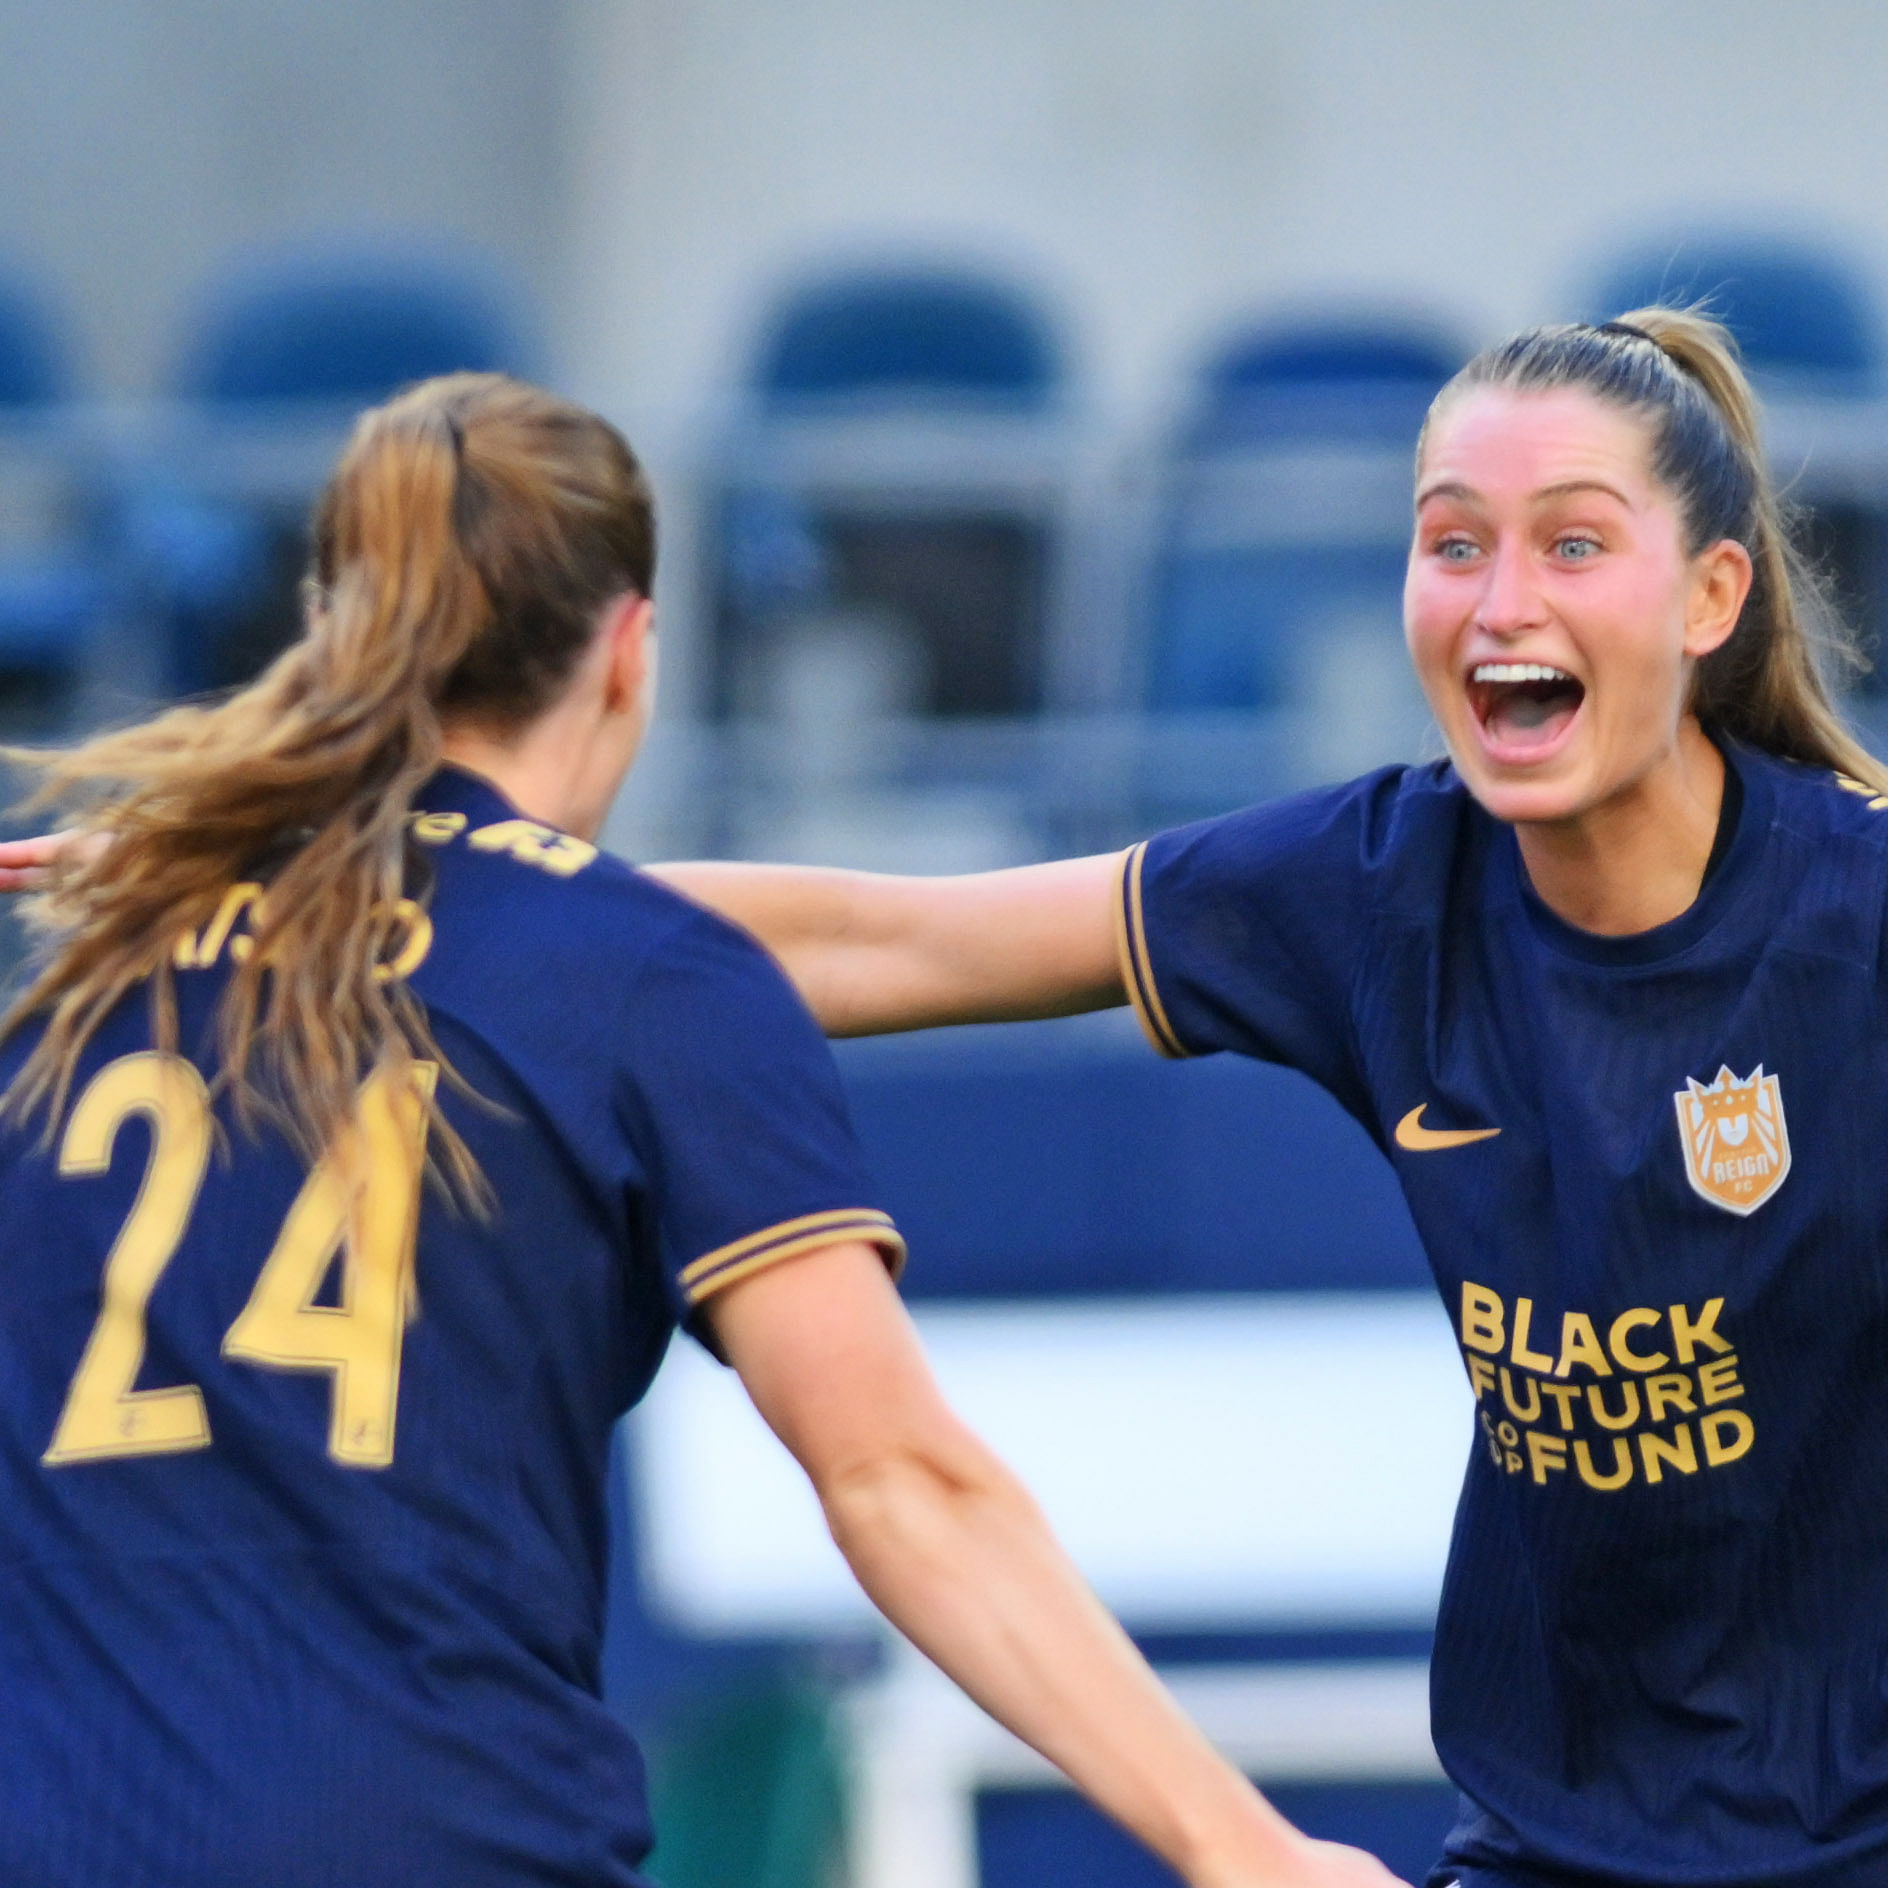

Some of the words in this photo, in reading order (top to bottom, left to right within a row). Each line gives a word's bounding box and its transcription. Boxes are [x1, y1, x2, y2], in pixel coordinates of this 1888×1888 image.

[42, 1050, 439, 1470] 24
[1462, 1280, 1734, 1377] BLACK
[1466, 1354, 1745, 1431] FUTURE
[1525, 1408, 1756, 1491] FUND
